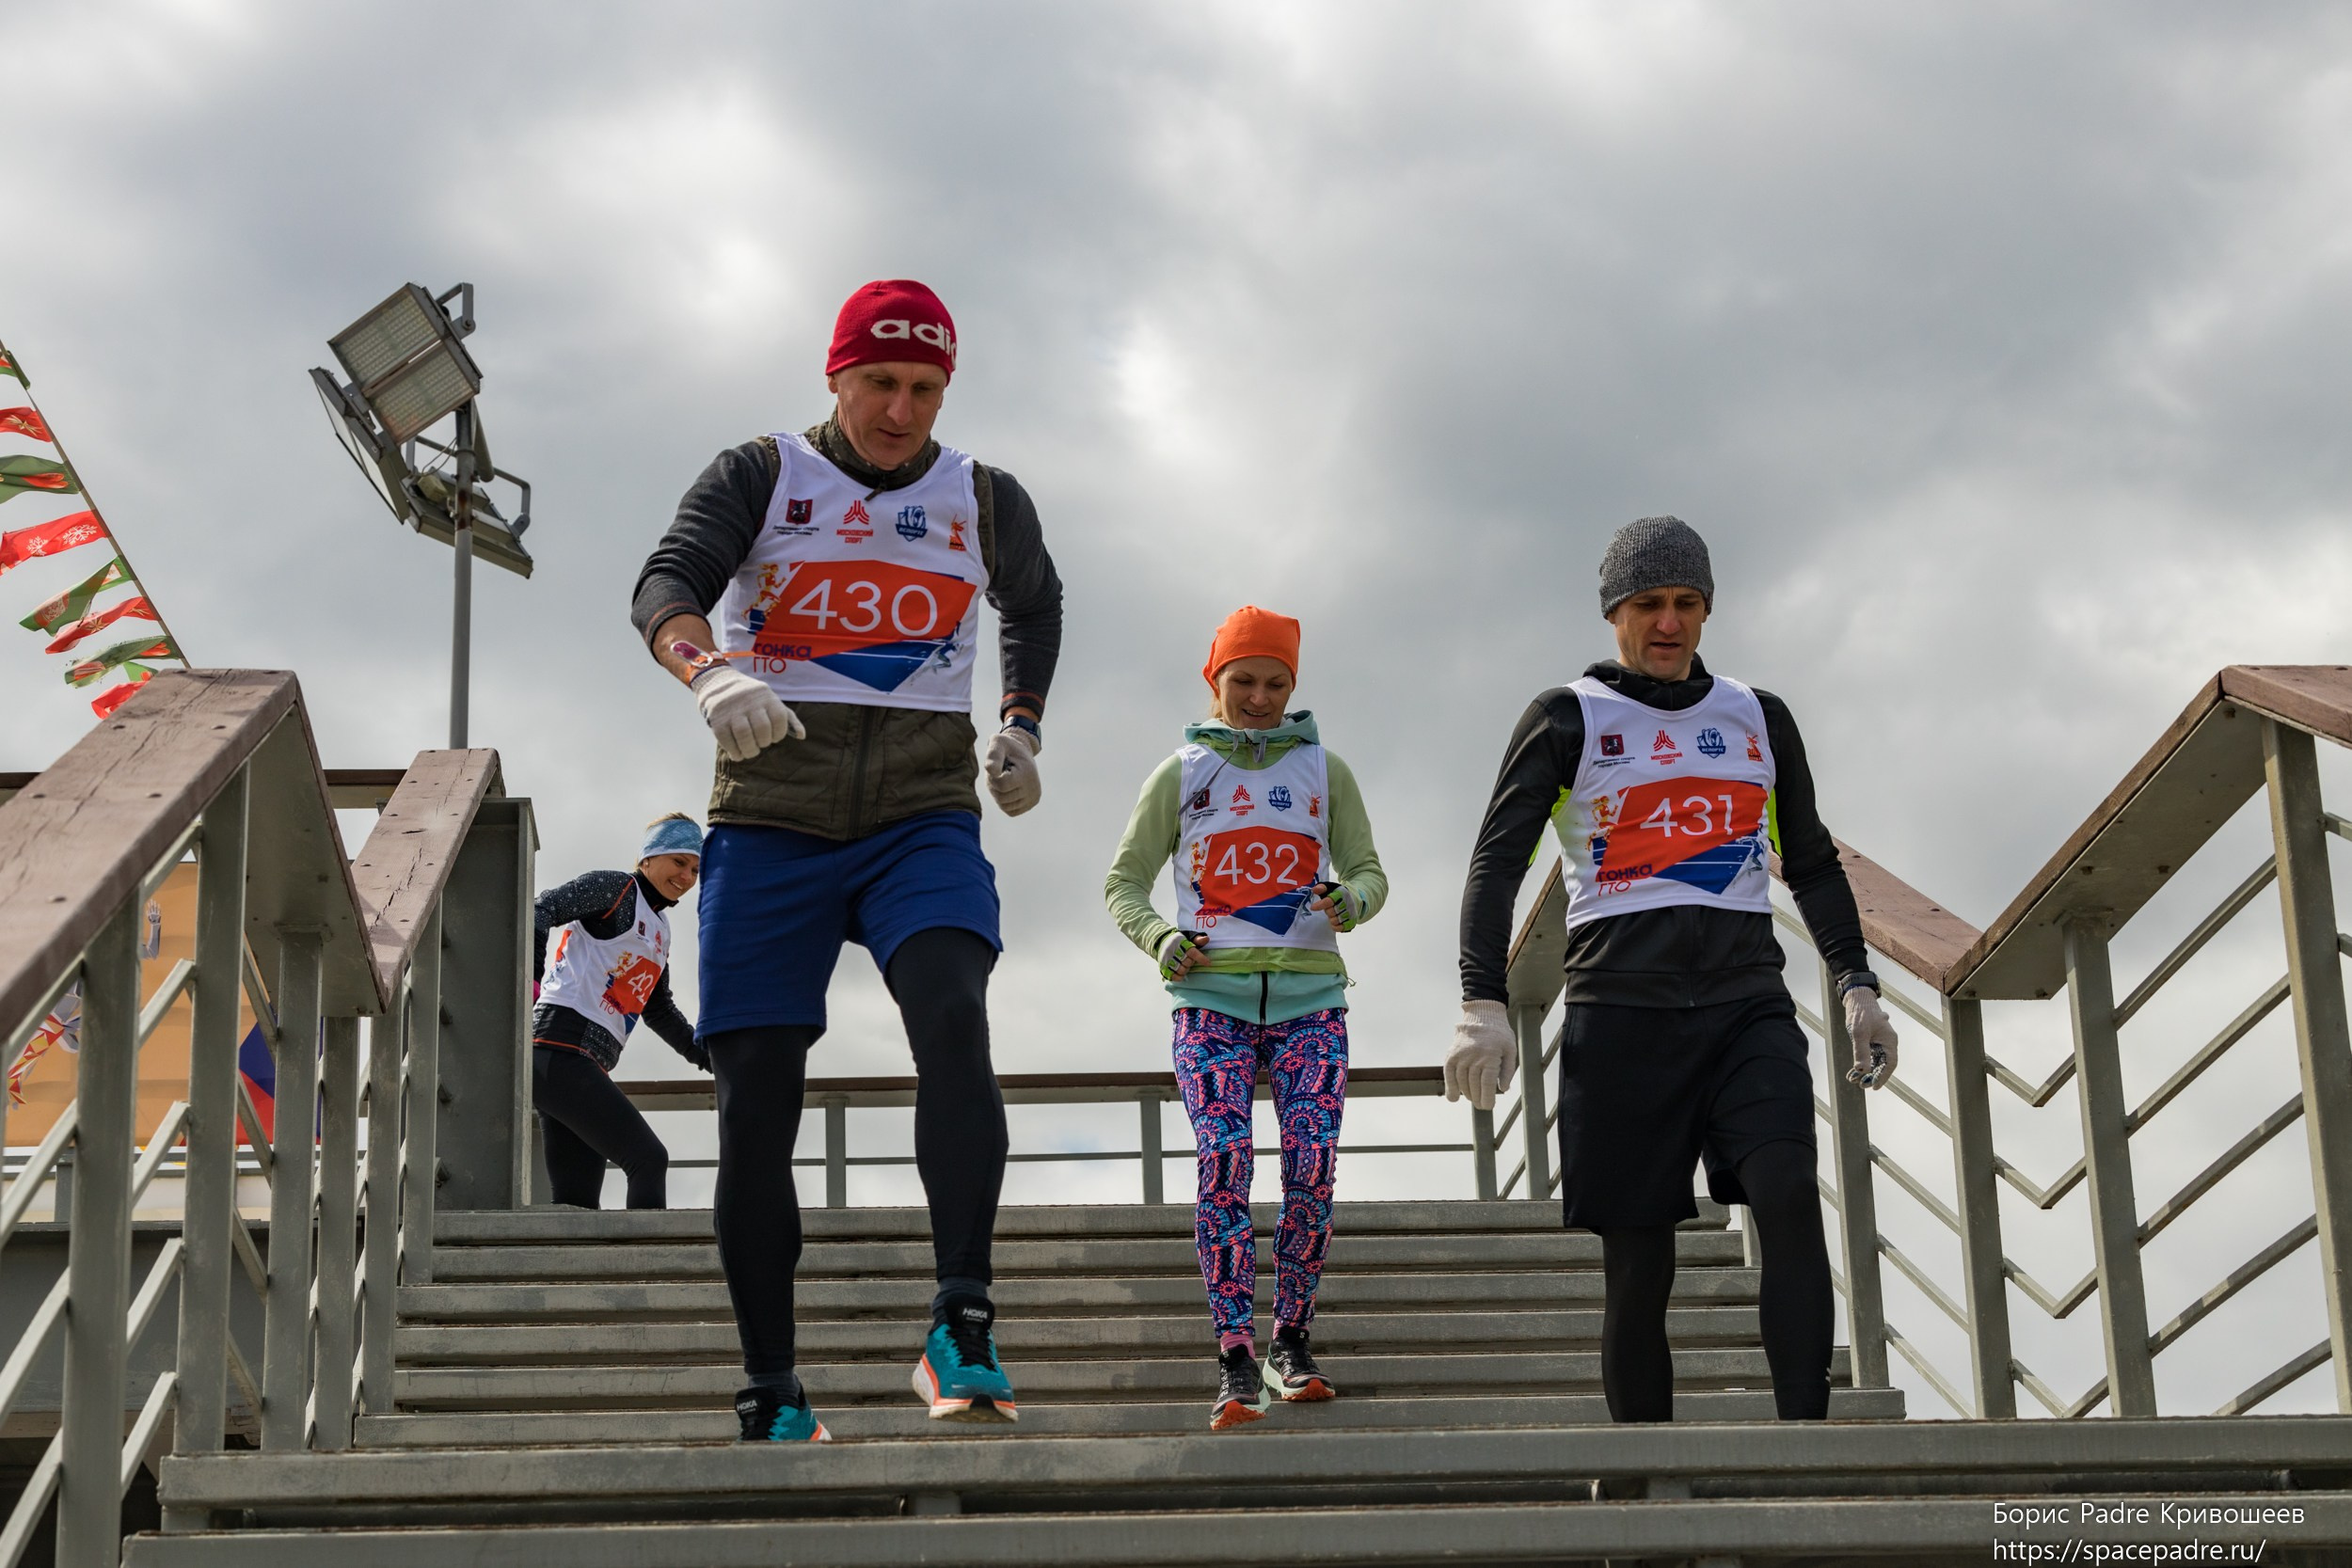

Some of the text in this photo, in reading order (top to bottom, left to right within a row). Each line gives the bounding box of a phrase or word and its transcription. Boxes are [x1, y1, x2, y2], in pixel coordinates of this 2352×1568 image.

[789, 578, 938, 637] 430
[754, 657, 787, 673] ГТО
[1640, 794, 1734, 838] 431
[1215, 842, 1300, 886] 432
[1598, 880, 1631, 896] ГТО
[1196, 915, 1217, 929] ГТО
[628, 970, 655, 1006] 42
[599, 999, 615, 1015] ГТО
[962, 1307, 988, 1320] HOKA
[737, 1400, 757, 1412] HOKA
